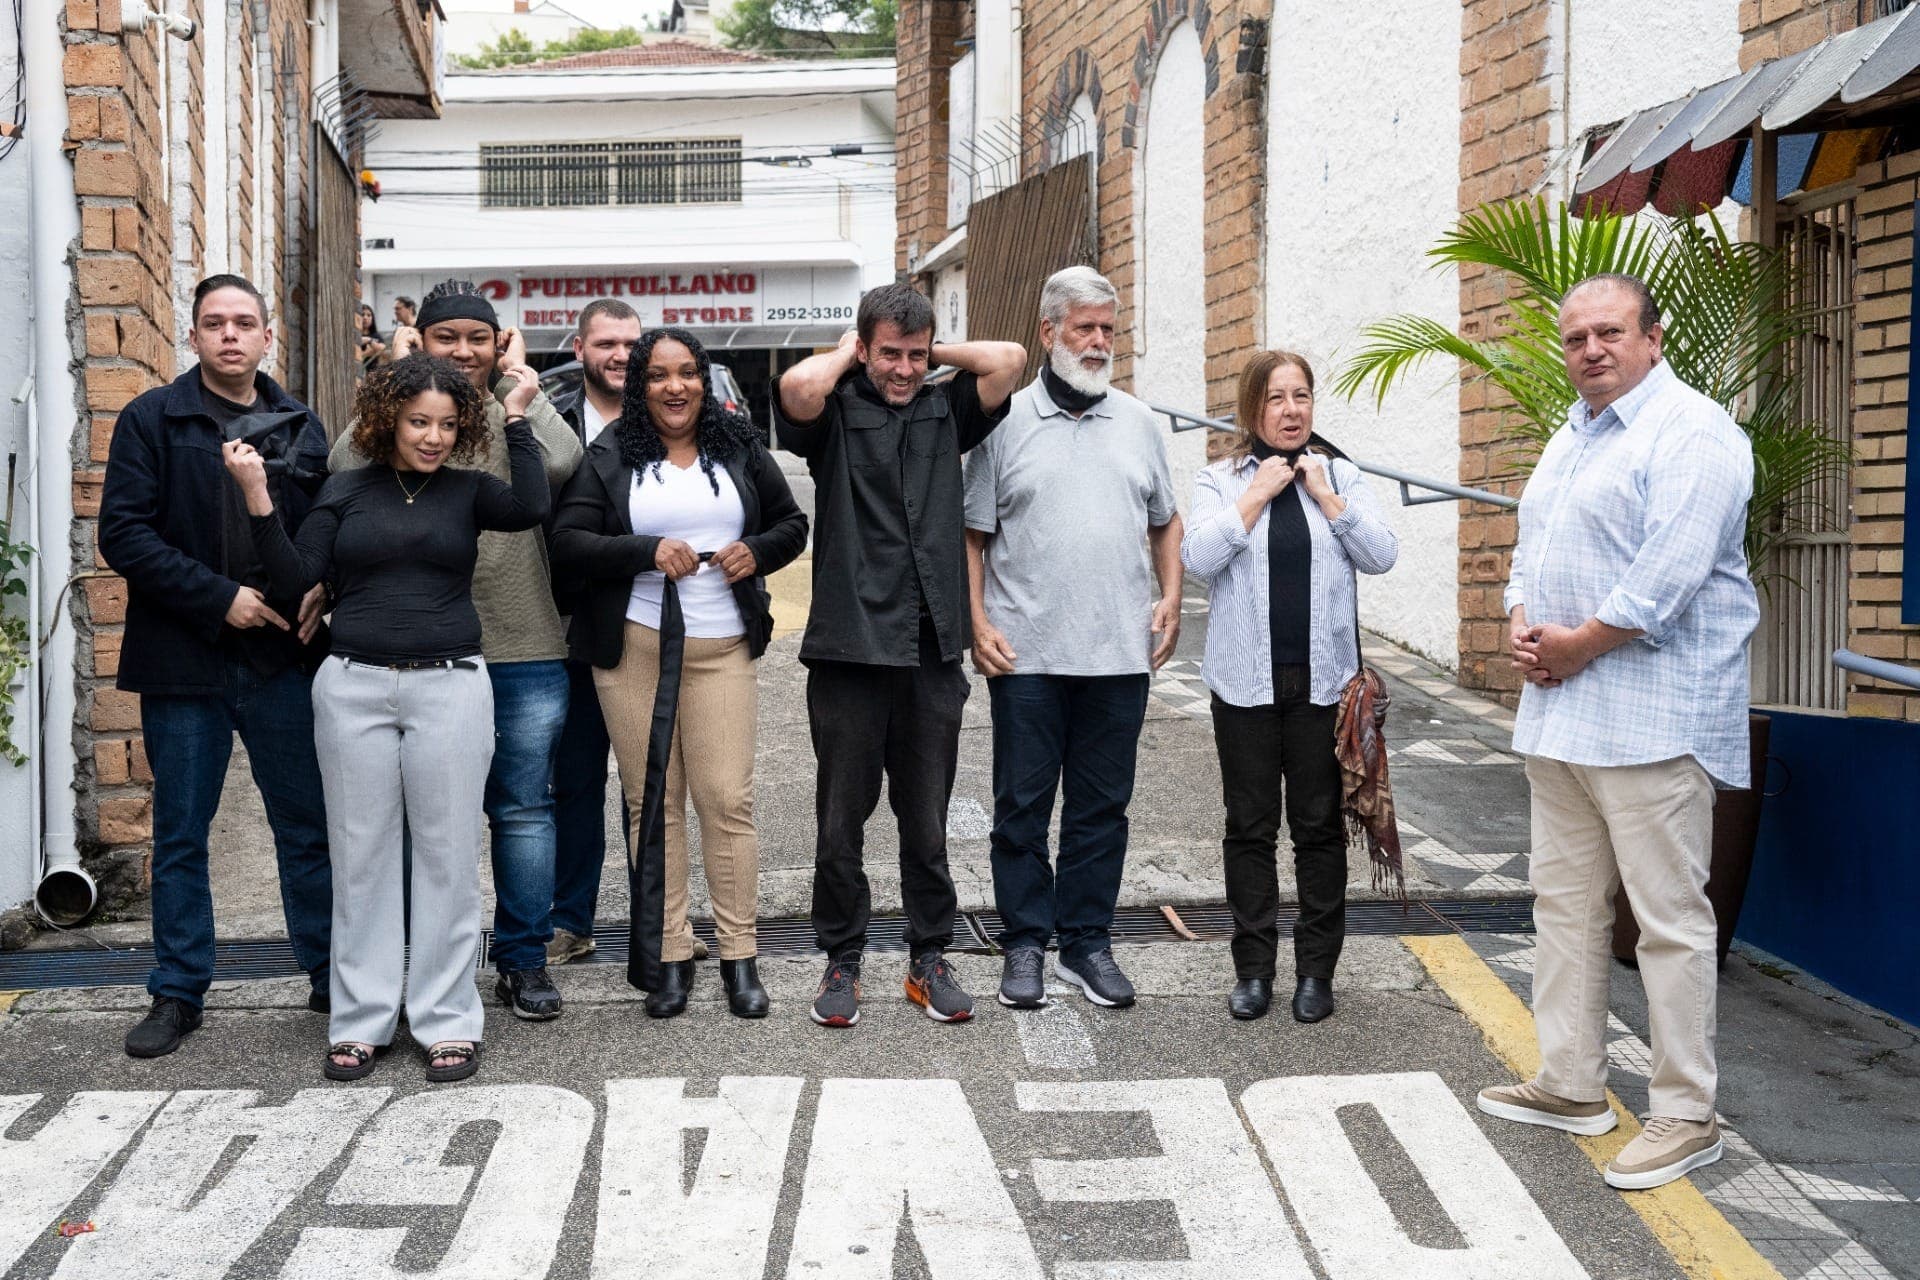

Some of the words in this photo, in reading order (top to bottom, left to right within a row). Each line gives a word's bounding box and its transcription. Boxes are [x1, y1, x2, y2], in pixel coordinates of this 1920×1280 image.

[519, 273, 756, 298] PUERTOLLANO
[523, 310, 579, 326] BICY
[662, 306, 753, 324] STORE
[766, 306, 853, 321] 2952-3380
